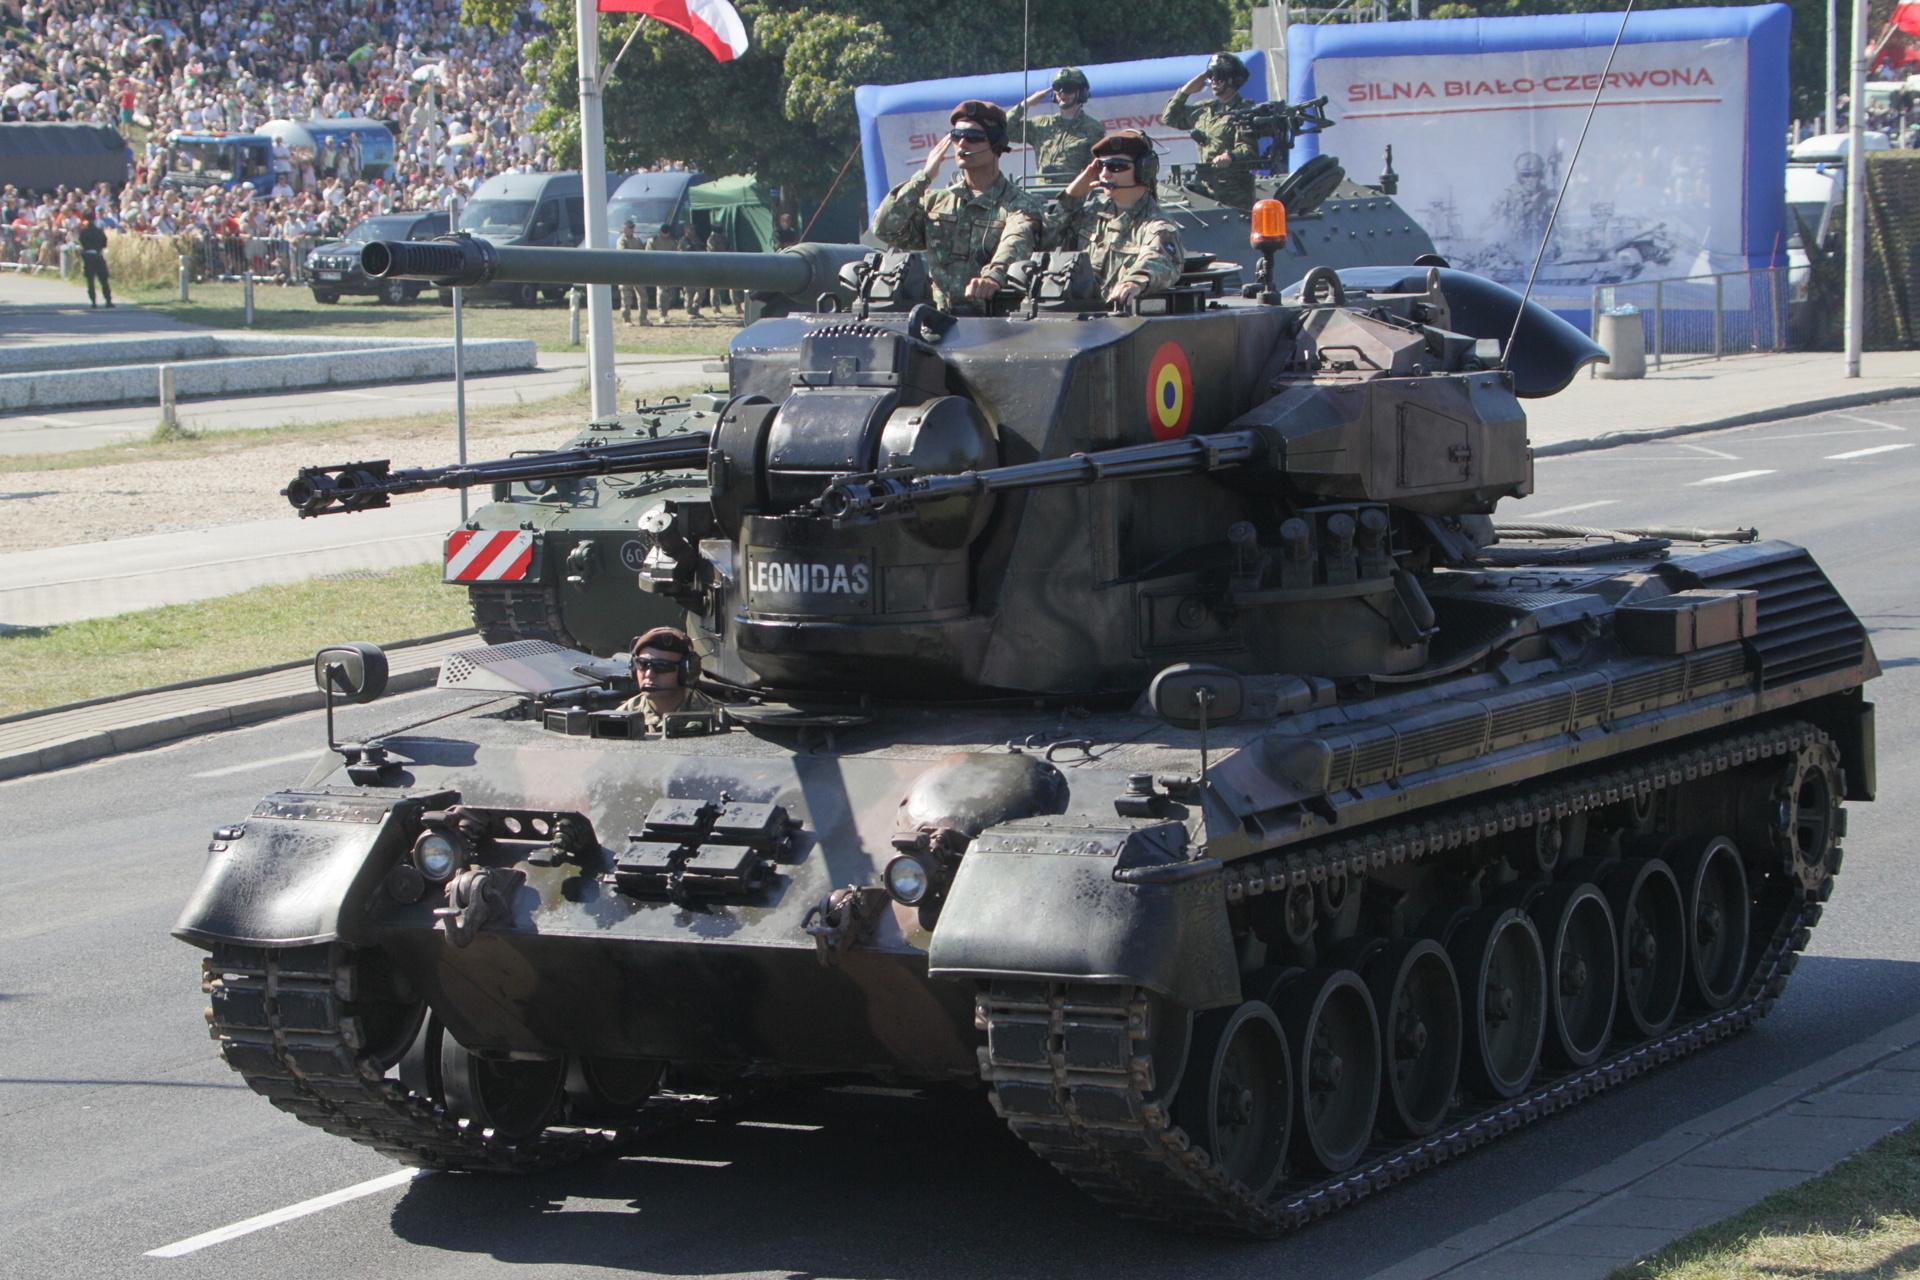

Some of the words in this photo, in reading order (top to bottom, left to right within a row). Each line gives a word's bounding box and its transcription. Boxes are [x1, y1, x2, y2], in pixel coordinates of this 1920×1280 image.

[1348, 81, 1435, 102] SILNA
[1443, 67, 1714, 97] BIAŁO-CZERWONA
[748, 561, 869, 594] LEONIDAS
